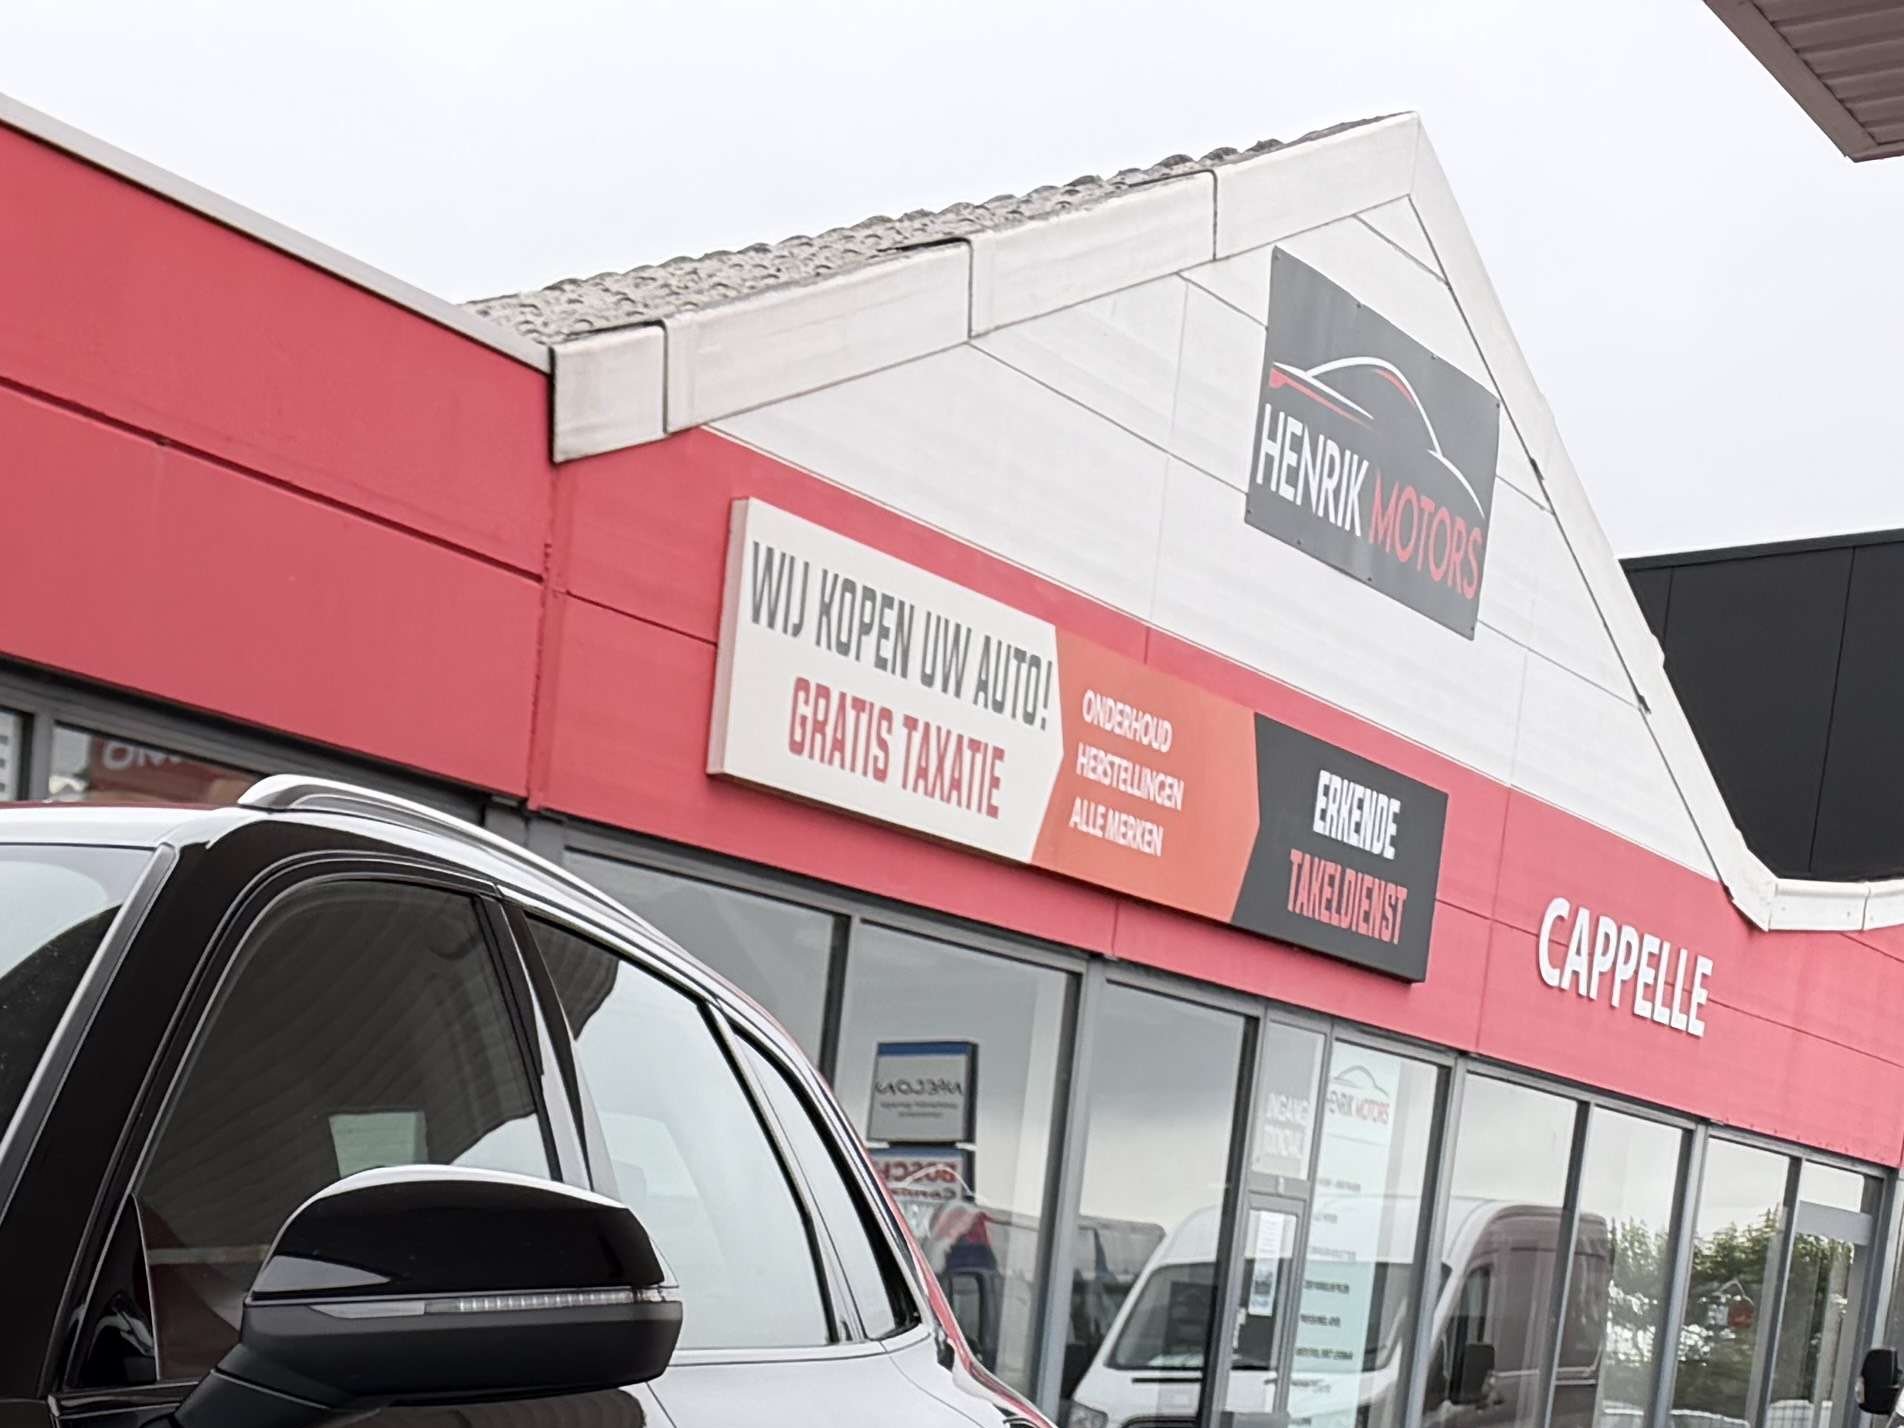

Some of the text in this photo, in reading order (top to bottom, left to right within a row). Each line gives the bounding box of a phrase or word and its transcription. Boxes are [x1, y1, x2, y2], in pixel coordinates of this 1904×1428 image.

[1256, 403, 1482, 600] HENRIK MOTORS
[751, 541, 1052, 731] WIJ KOPEN UW AUTO!
[788, 677, 1005, 819] GRATIS TAXATIE
[1082, 689, 1173, 753] ONDERHOUD
[1076, 743, 1184, 811] HERSTELLINGEN
[1313, 769, 1401, 859] ERKENDE
[1069, 797, 1164, 857] ALLE MERKEN
[1287, 848, 1408, 944] TAKELDIENST
[1538, 897, 1714, 1038] CAPPELLE
